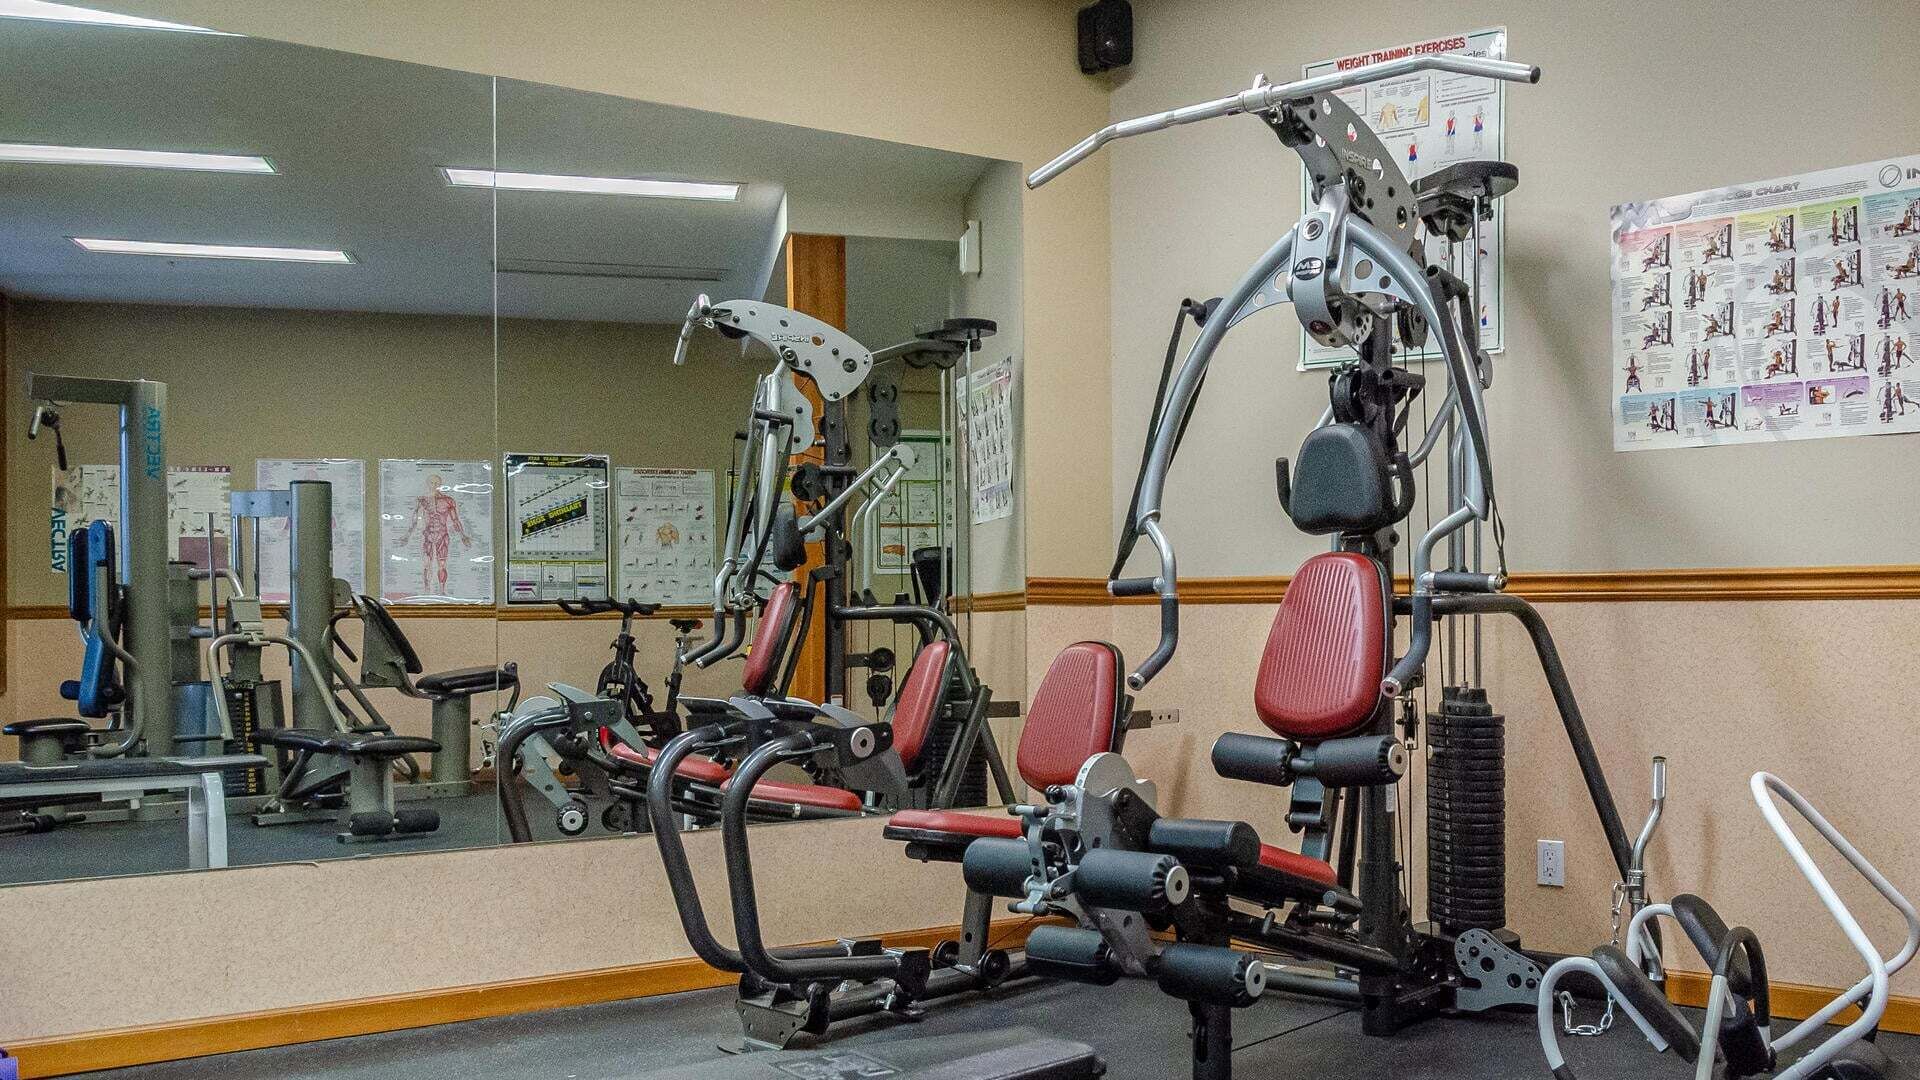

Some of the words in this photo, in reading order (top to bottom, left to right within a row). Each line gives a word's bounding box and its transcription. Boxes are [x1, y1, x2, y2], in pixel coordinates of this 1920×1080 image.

[1337, 55, 1370, 71] WEIGHT
[1371, 47, 1412, 63] TRAINING
[1415, 37, 1466, 54] EXERCISES
[1341, 147, 1373, 169] INSPIRE
[1755, 181, 1800, 196] CHART
